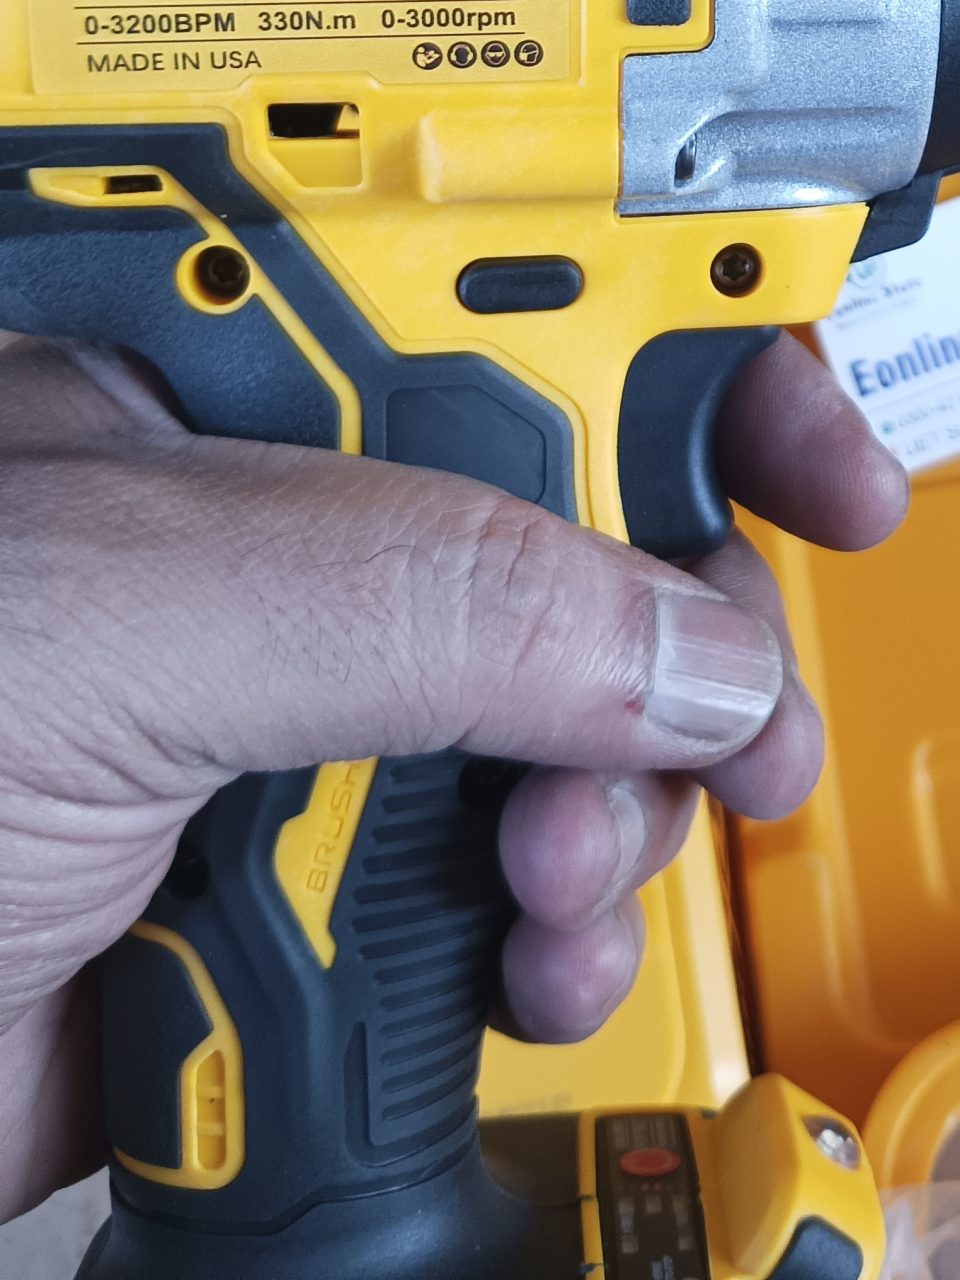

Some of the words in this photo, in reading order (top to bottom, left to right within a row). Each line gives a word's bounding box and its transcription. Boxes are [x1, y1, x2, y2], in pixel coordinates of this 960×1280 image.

[84, 12, 236, 36] 0-3200BPM
[257, 10, 357, 33] 330N.m
[381, 7, 517, 32] 0-3000rpm
[86, 52, 166, 73] MADE
[173, 51, 201, 71] IN
[210, 50, 263, 70] USA
